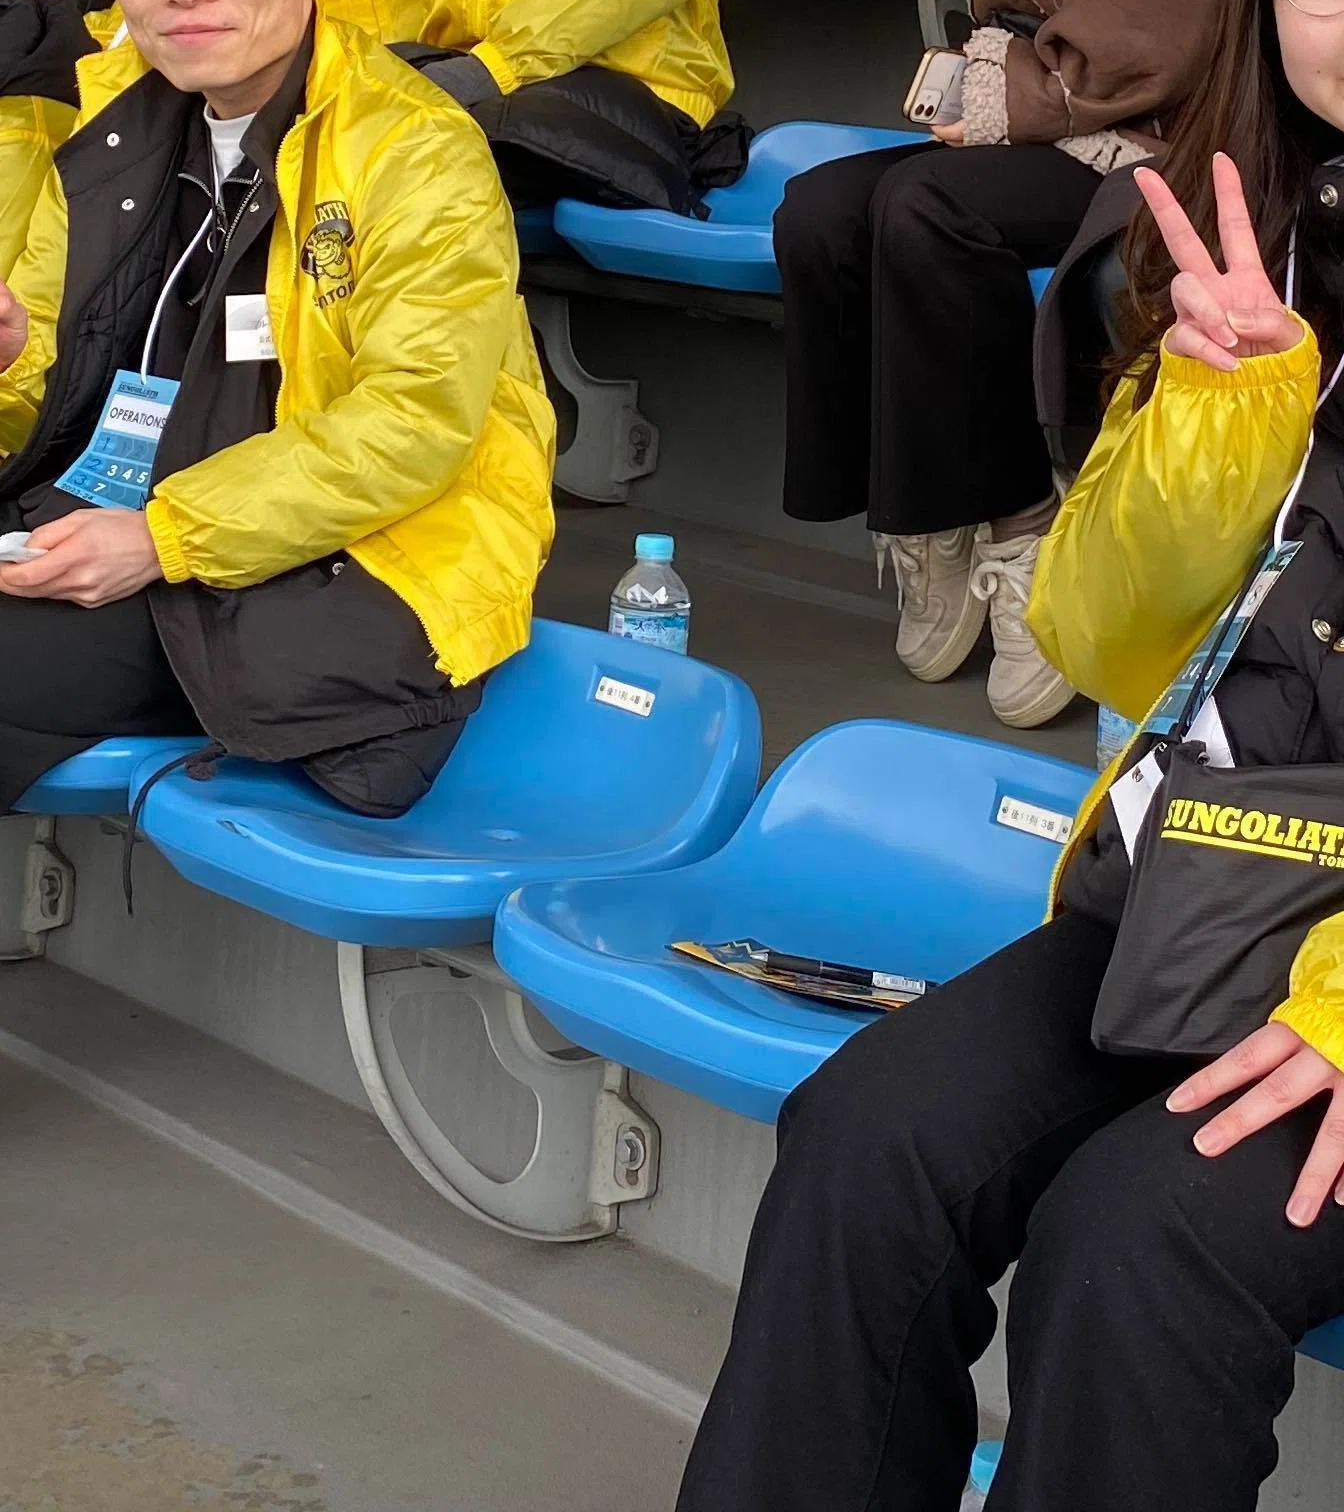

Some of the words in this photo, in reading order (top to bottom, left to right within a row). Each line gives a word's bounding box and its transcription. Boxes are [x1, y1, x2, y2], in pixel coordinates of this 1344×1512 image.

[109, 407, 168, 429] OPERATIONS
[107, 464, 119, 477] 3
[122, 468, 134, 481] 4
[136, 471, 149, 484] 5
[93, 483, 106, 492] 7
